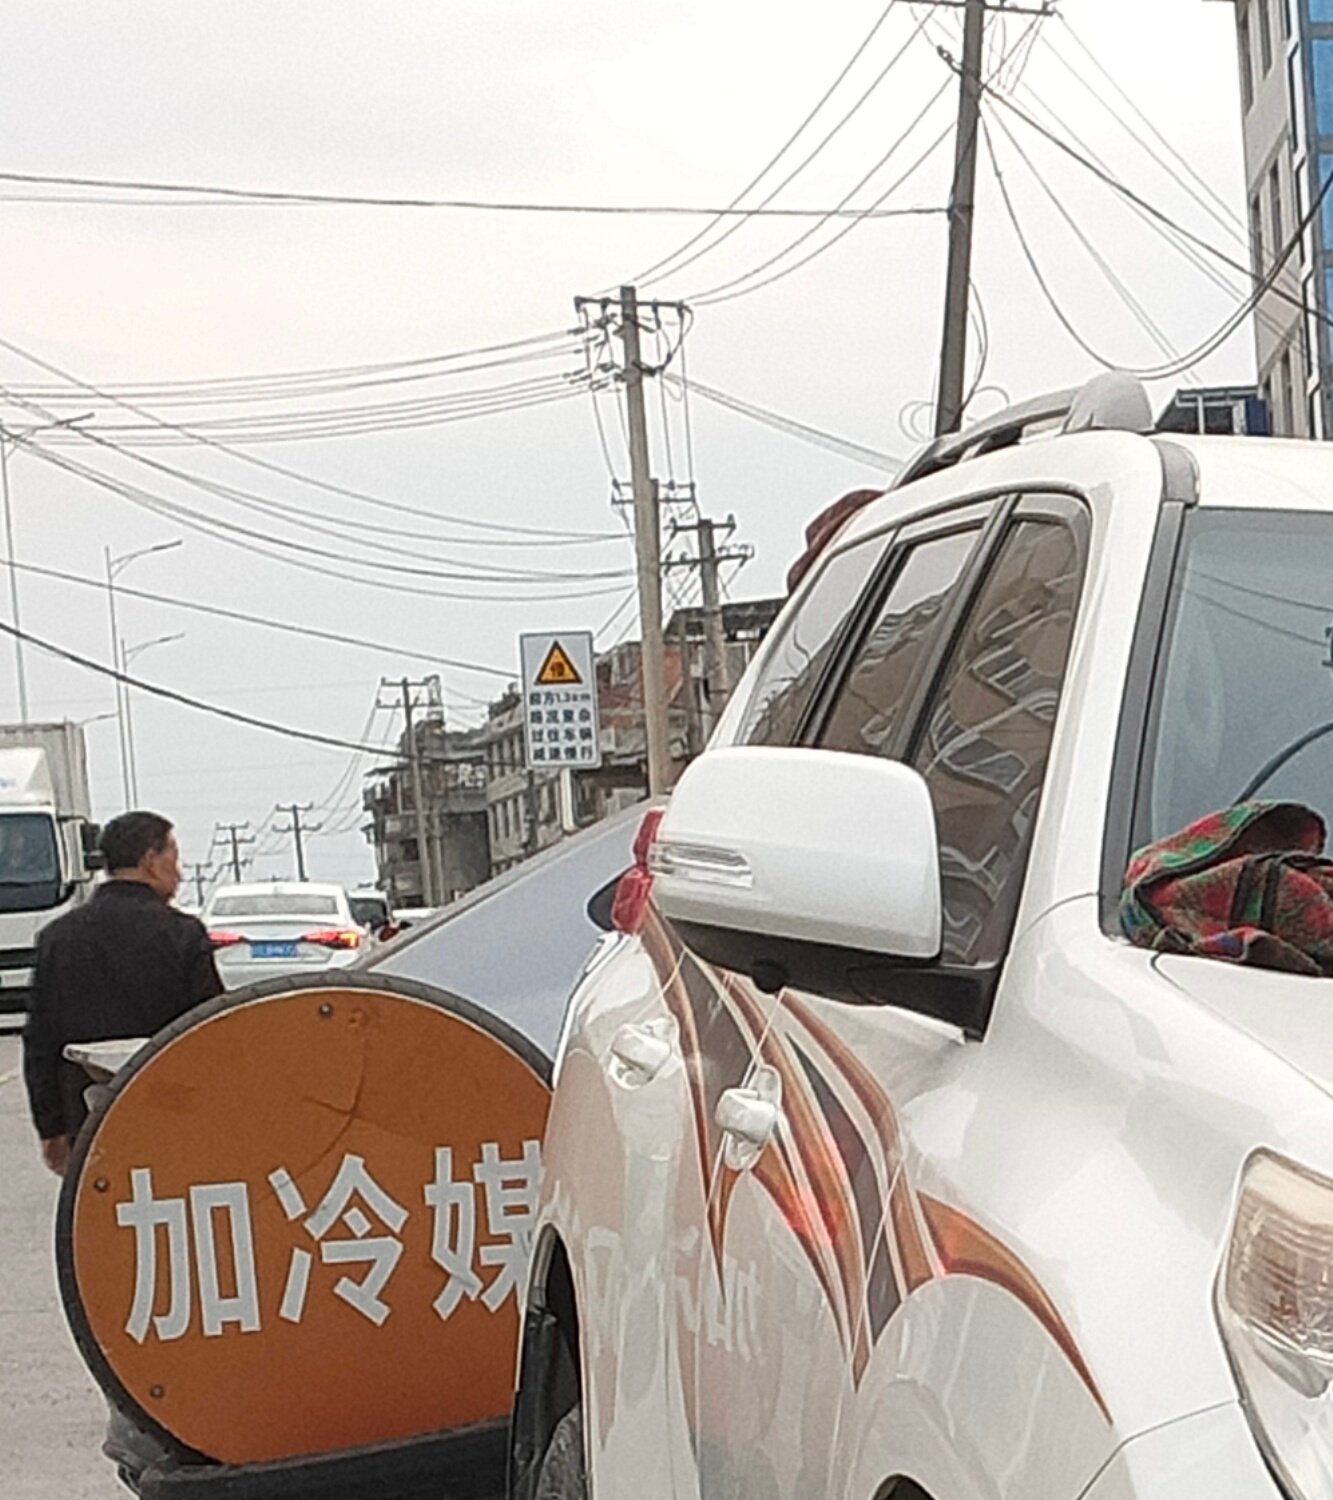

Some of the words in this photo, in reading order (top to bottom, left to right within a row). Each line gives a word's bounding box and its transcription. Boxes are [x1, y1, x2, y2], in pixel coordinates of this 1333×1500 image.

[532, 728, 592, 742] 过往车辆
[534, 746, 593, 760] 减速慢行
[115, 1139, 546, 1345] 加冷媒
